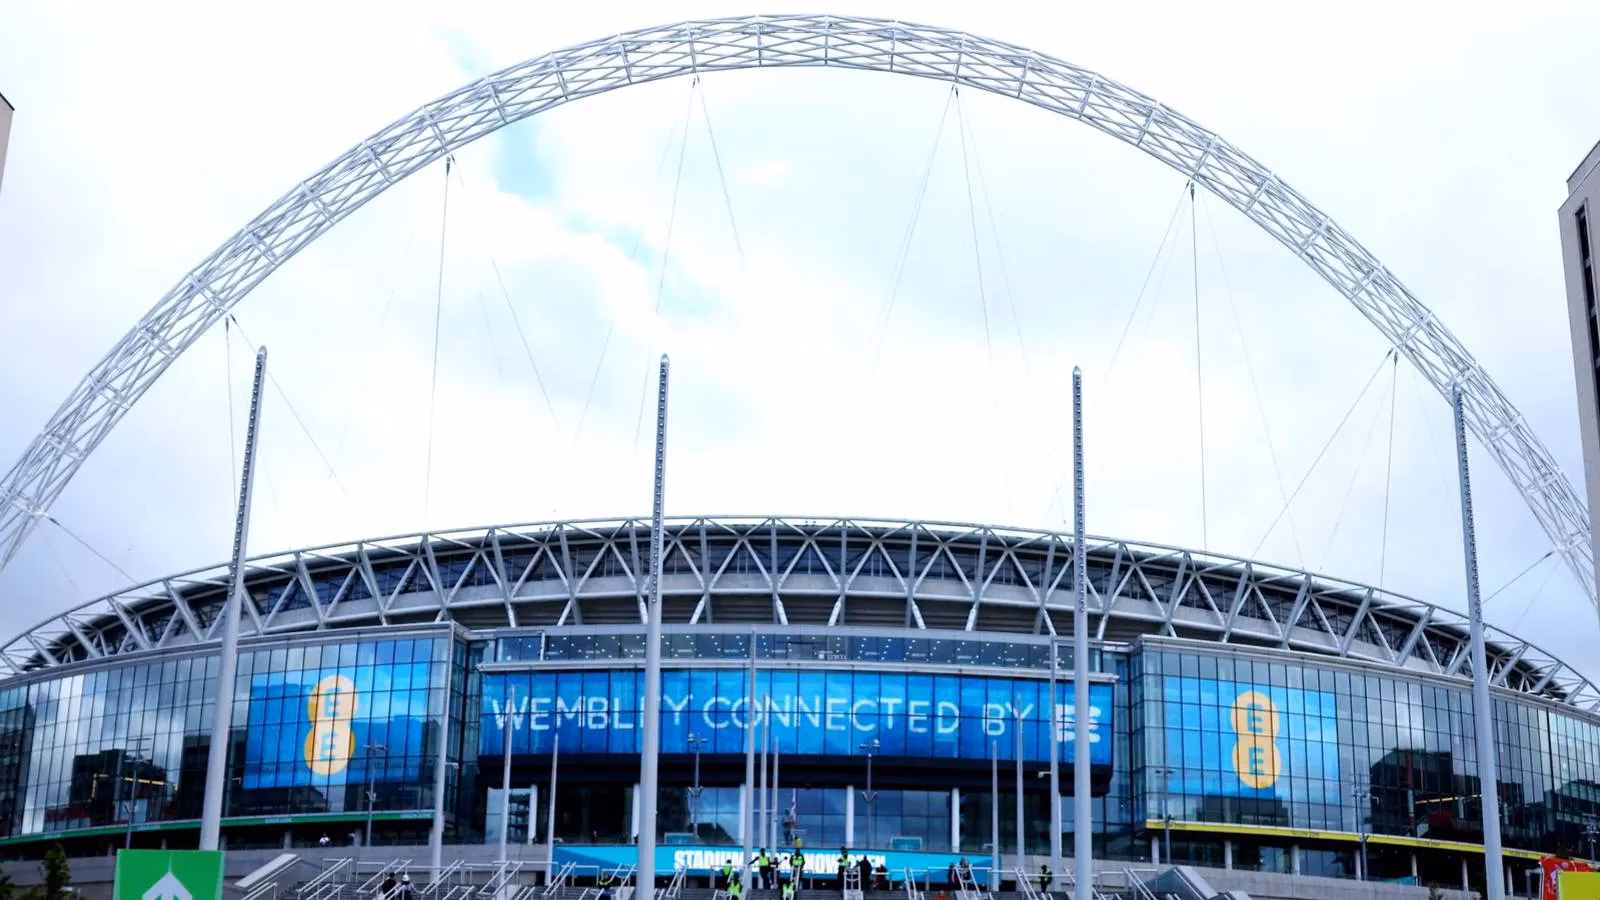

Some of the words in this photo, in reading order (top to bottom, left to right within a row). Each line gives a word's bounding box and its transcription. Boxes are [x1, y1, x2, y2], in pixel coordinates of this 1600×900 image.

[492, 694, 693, 731] WEMBLY
[703, 694, 960, 734] CONNECTED
[982, 702, 1034, 737] BY
